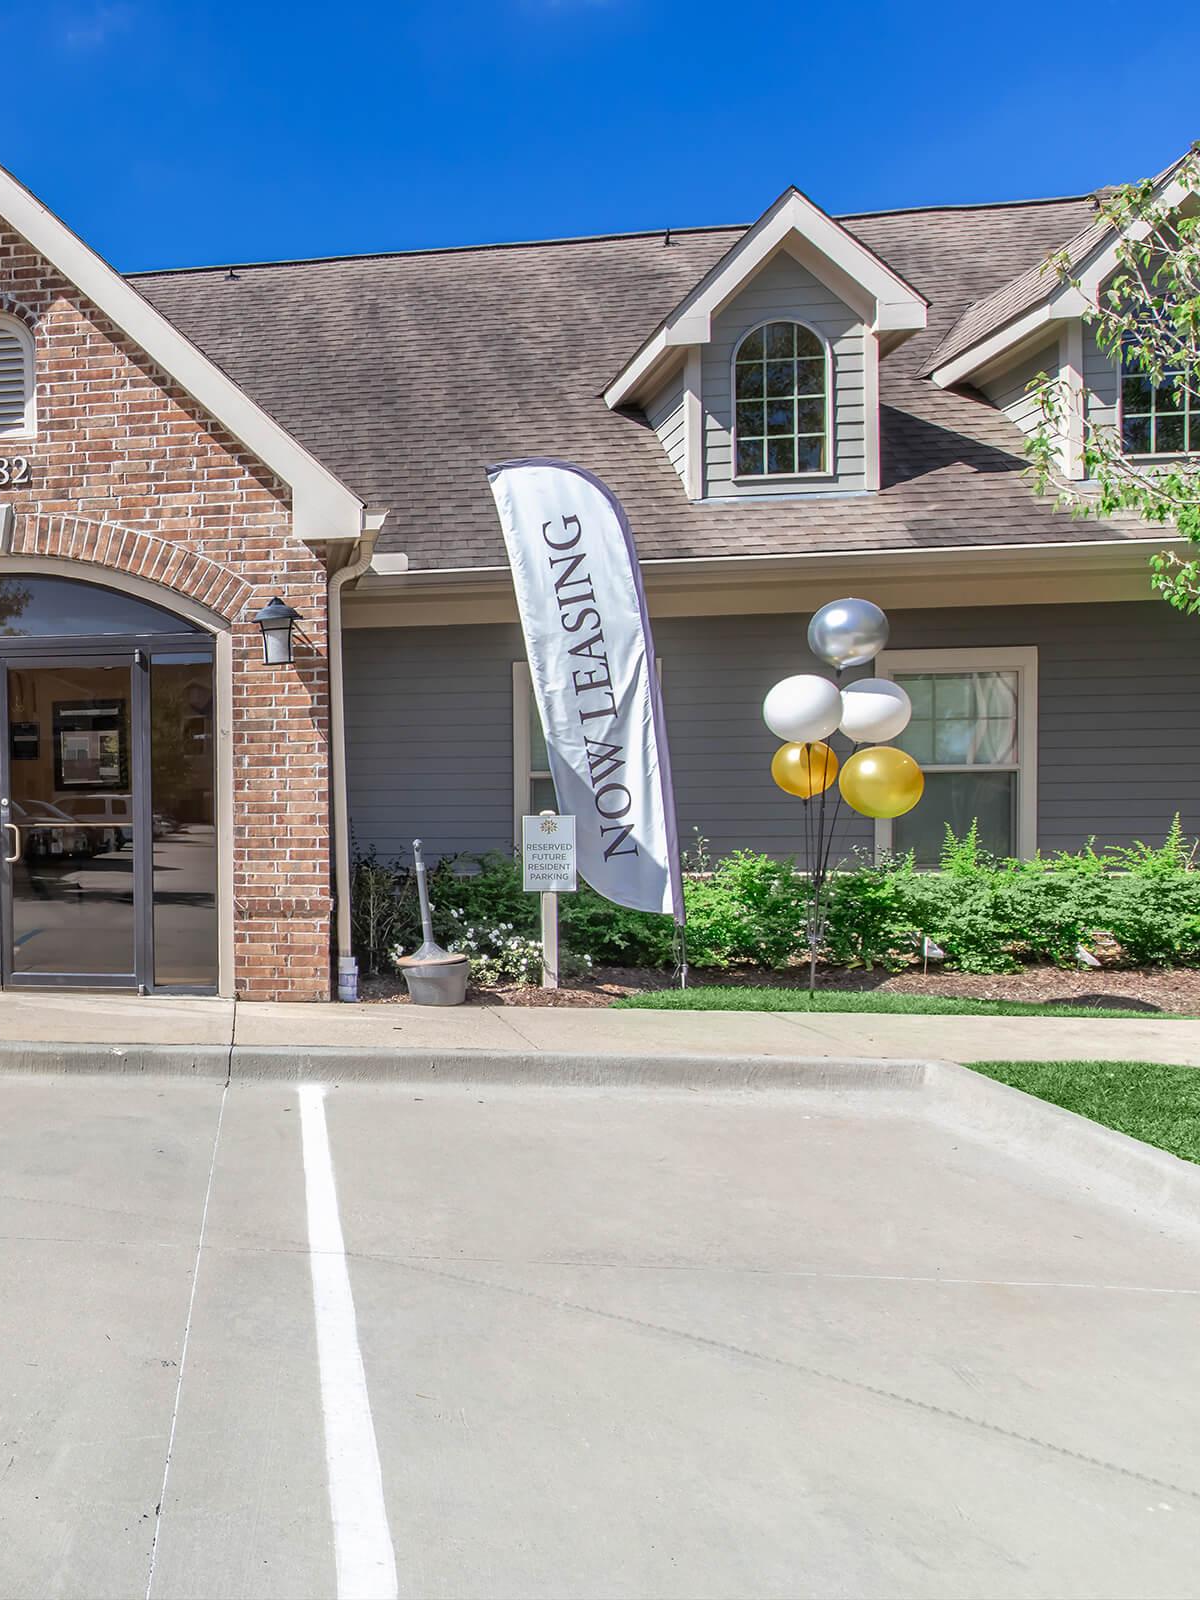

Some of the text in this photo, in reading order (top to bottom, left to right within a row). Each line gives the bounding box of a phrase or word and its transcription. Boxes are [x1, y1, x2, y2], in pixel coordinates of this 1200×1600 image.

[542, 513, 640, 863] NOW LEASING
[526, 843, 573, 851] RESERVED
[531, 853, 567, 861] FUTURE
[527, 863, 571, 871] RESIDENT
[530, 873, 569, 881] PARKING
